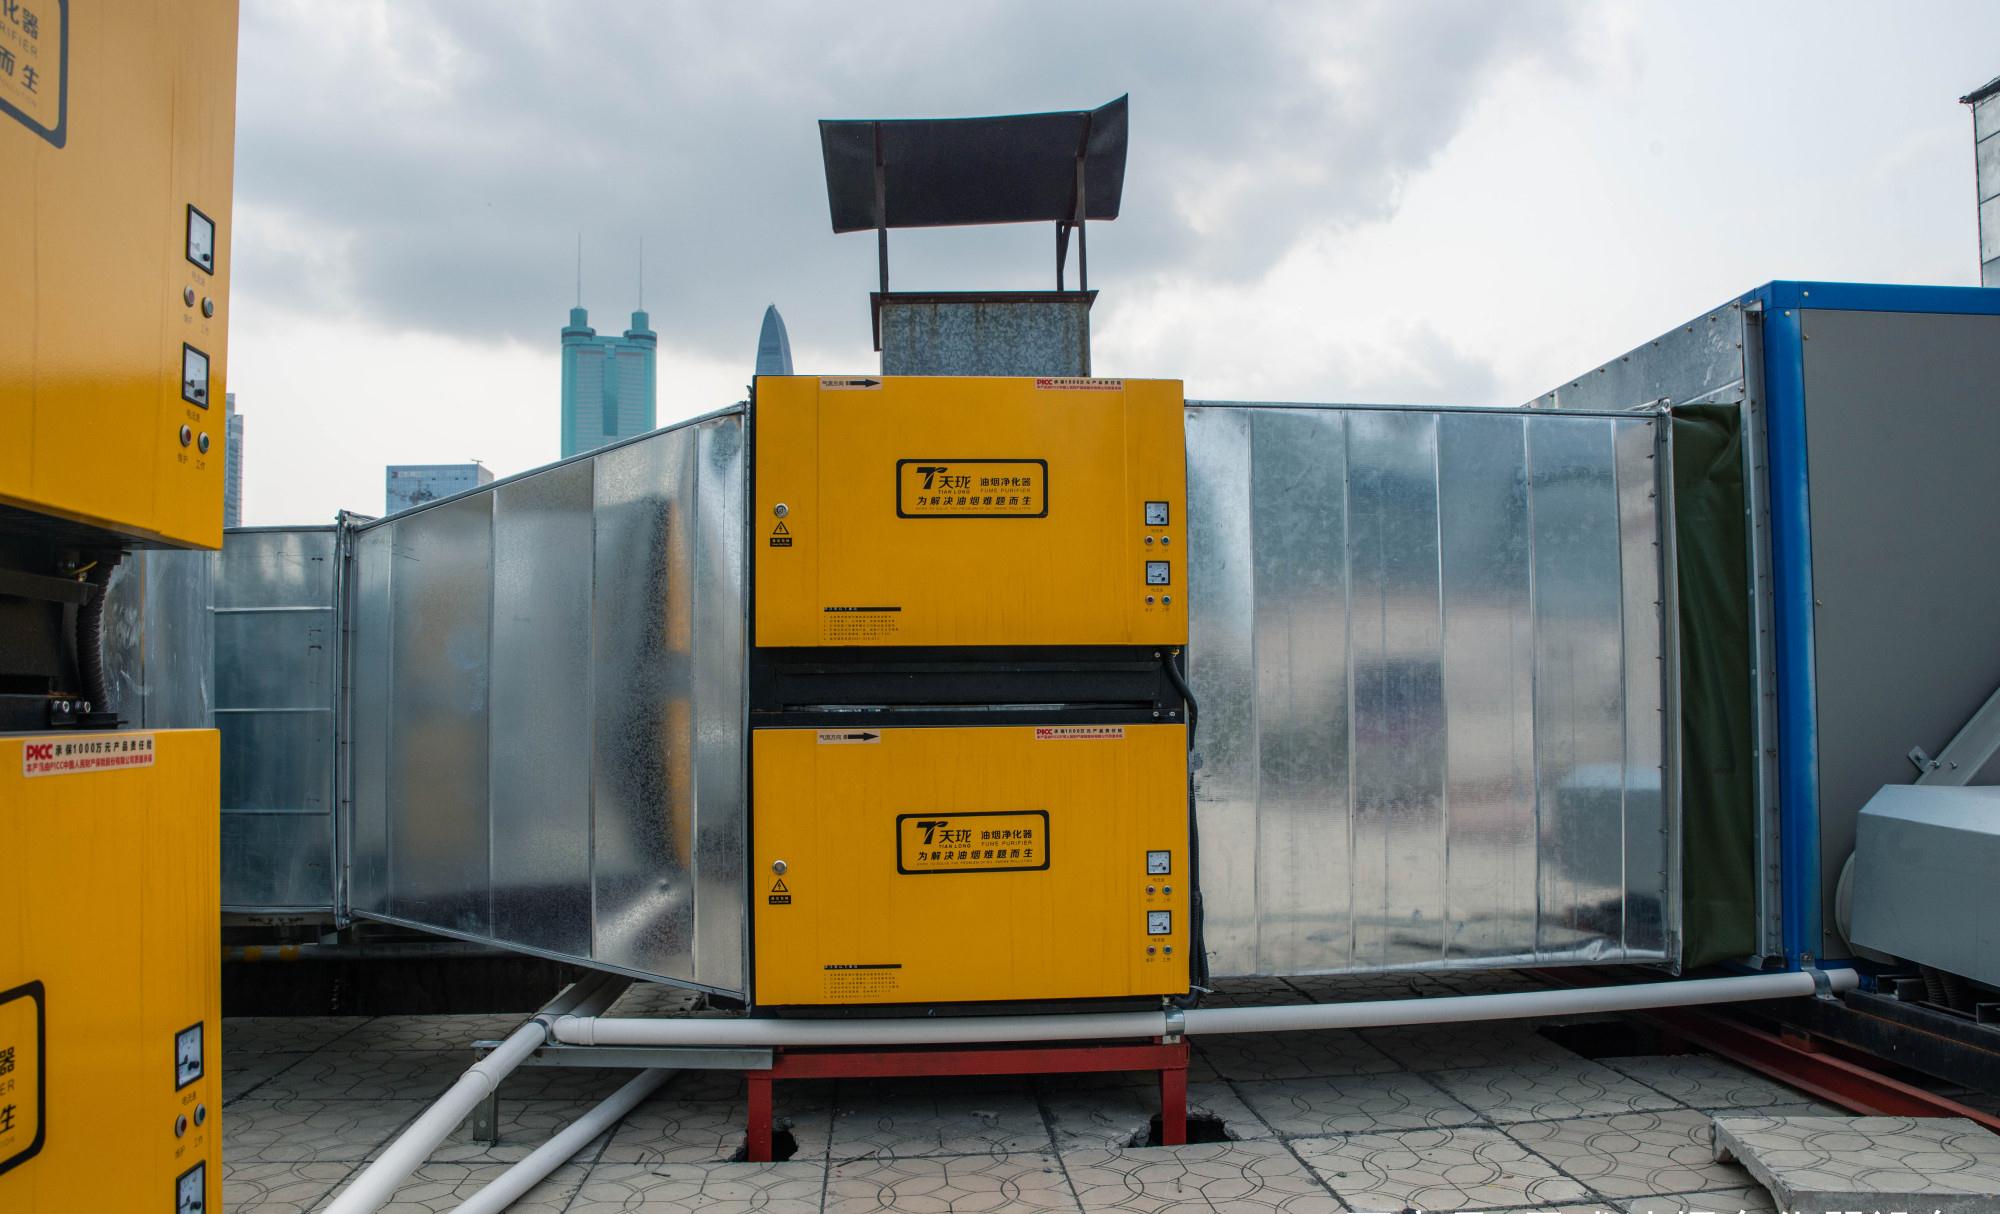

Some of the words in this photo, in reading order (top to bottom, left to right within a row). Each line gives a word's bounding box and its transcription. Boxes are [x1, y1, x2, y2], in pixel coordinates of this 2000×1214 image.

[938, 475, 971, 489] 天珑
[980, 477, 1031, 487] 油烟净化器
[917, 496, 1032, 506] 为解决油烟难题而生
[26, 744, 53, 760] PICC
[939, 829, 972, 844] 天珑
[981, 830, 1032, 840] 油烟净化器
[918, 848, 1033, 861] 为解决油烟难题而生
